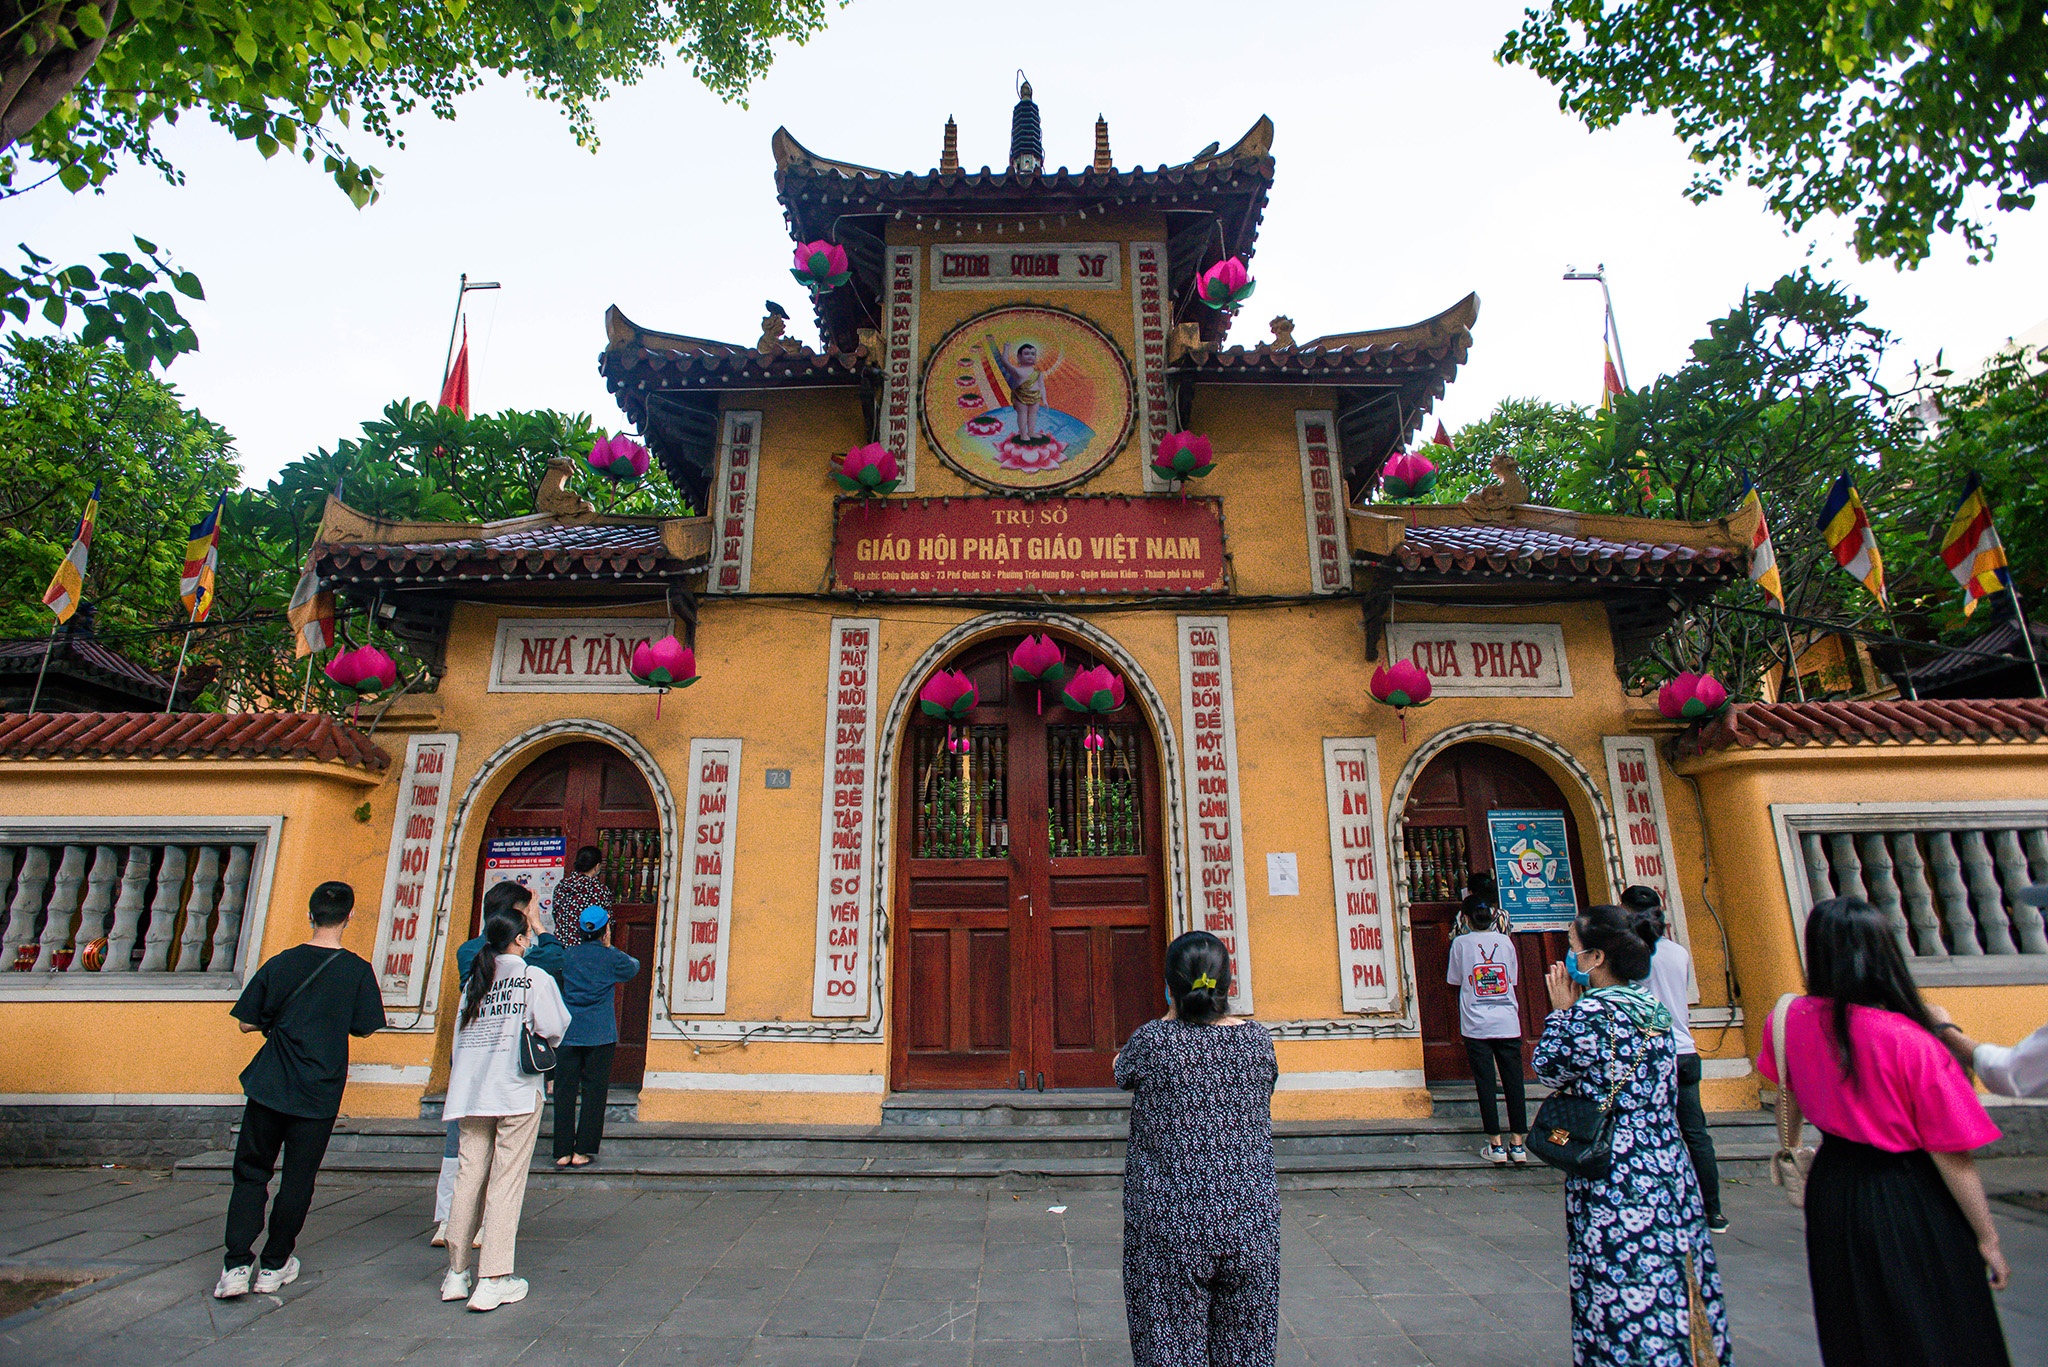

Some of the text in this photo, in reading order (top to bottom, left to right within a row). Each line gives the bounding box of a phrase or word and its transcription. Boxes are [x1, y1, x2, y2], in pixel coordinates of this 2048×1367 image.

[992, 504, 1068, 528] TRỤ SỞ
[856, 532, 1201, 565] GIÁO HỘI PHẬT GIÁO VIỆT NAM
[936, 571, 946, 580] 73
[842, 630, 868, 648] HỘI
[583, 633, 651, 676] TĂN
[841, 648, 867, 668] PHẬT
[839, 667, 866, 686] ĐỦ
[1192, 672, 1220, 688] CHUNG
[1192, 688, 1222, 708] BỐN
[1196, 730, 1223, 752] MỘT
[416, 748, 444, 774] CHÙA
[836, 744, 865, 765] CHÚNG
[1196, 752, 1226, 772] NHÀ
[702, 759, 729, 782] CẢNH
[771, 772, 786, 785] 73
[1336, 760, 1366, 782] TAI
[410, 785, 440, 806] TRUNG
[699, 788, 726, 816] QUÁN
[834, 808, 863, 830] TẬP
[832, 829, 862, 850] PHÚC
[1200, 822, 1229, 840] TU
[1342, 826, 1372, 849] LUI
[695, 850, 722, 876] NHÀ
[1344, 852, 1374, 880] TỚI
[1526, 862, 1539, 870] 5K
[1634, 855, 1662, 877] NOI
[693, 883, 720, 907] TĂNG
[830, 874, 860, 895] SƠ
[394, 883, 424, 909] PHẬT
[1346, 888, 1378, 916] KHÁCH
[829, 926, 858, 946] CẬN
[688, 954, 716, 983] NỐI
[829, 952, 858, 975] TỰ
[488, 977, 532, 992] ANTAGES
[1352, 964, 1386, 988] PHA
[485, 990, 512, 1005] BEING
[827, 980, 856, 997] DO
